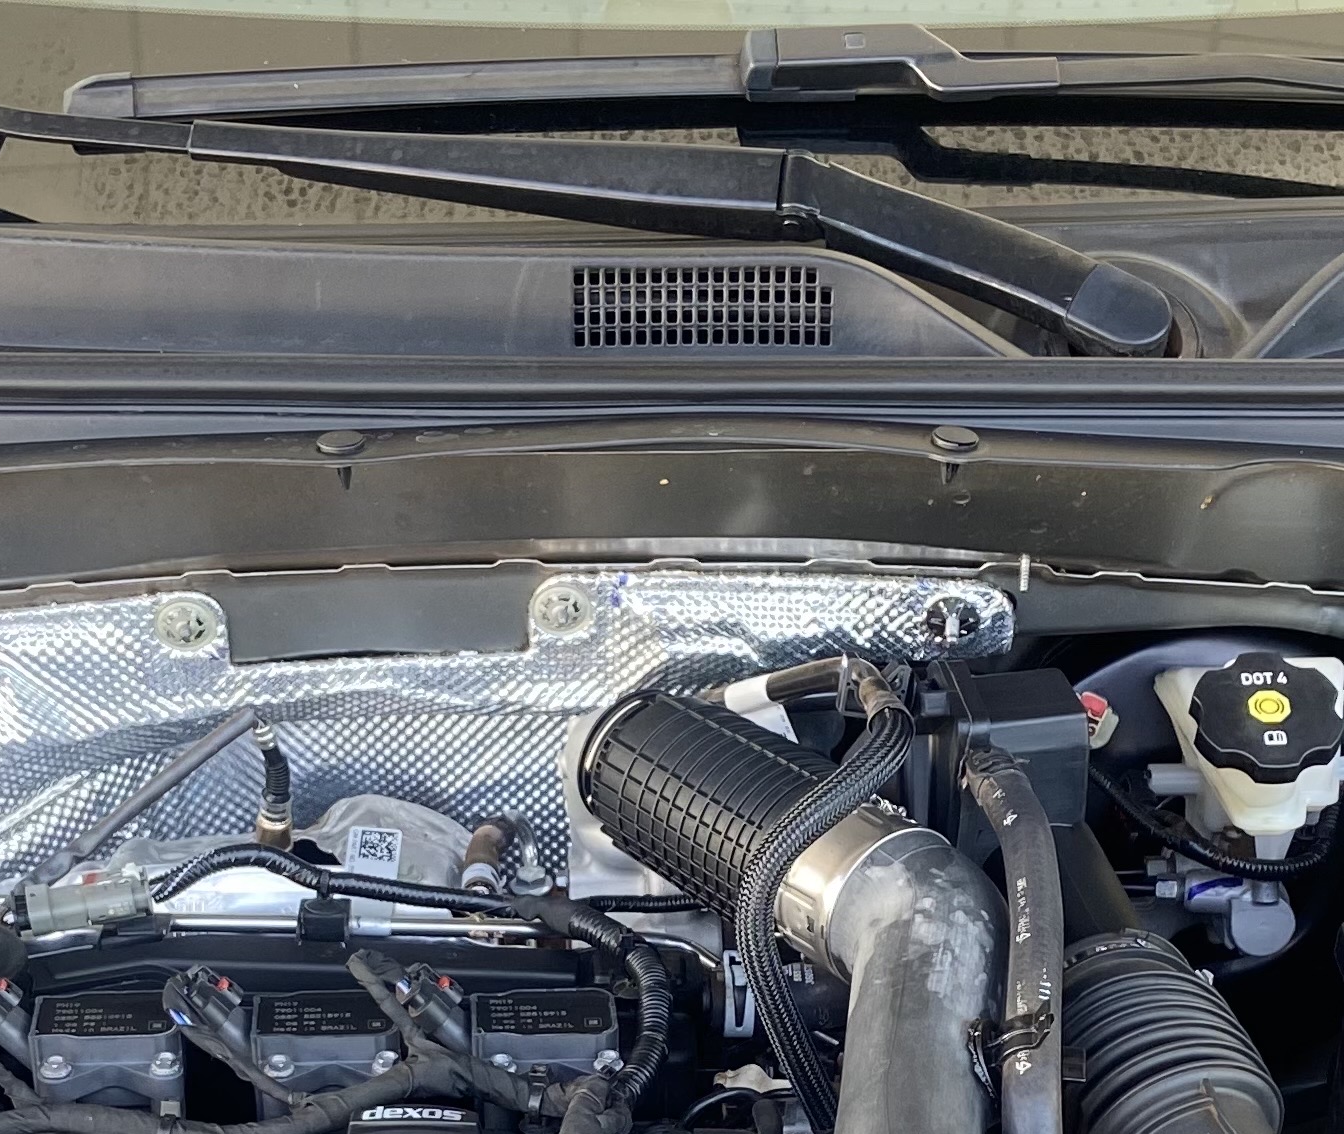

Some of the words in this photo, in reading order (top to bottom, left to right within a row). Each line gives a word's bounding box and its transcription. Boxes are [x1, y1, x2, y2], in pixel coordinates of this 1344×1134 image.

[1240, 671, 1271, 687] DOT
[1274, 671, 1288, 686] 4
[362, 1106, 463, 1121] dexos
